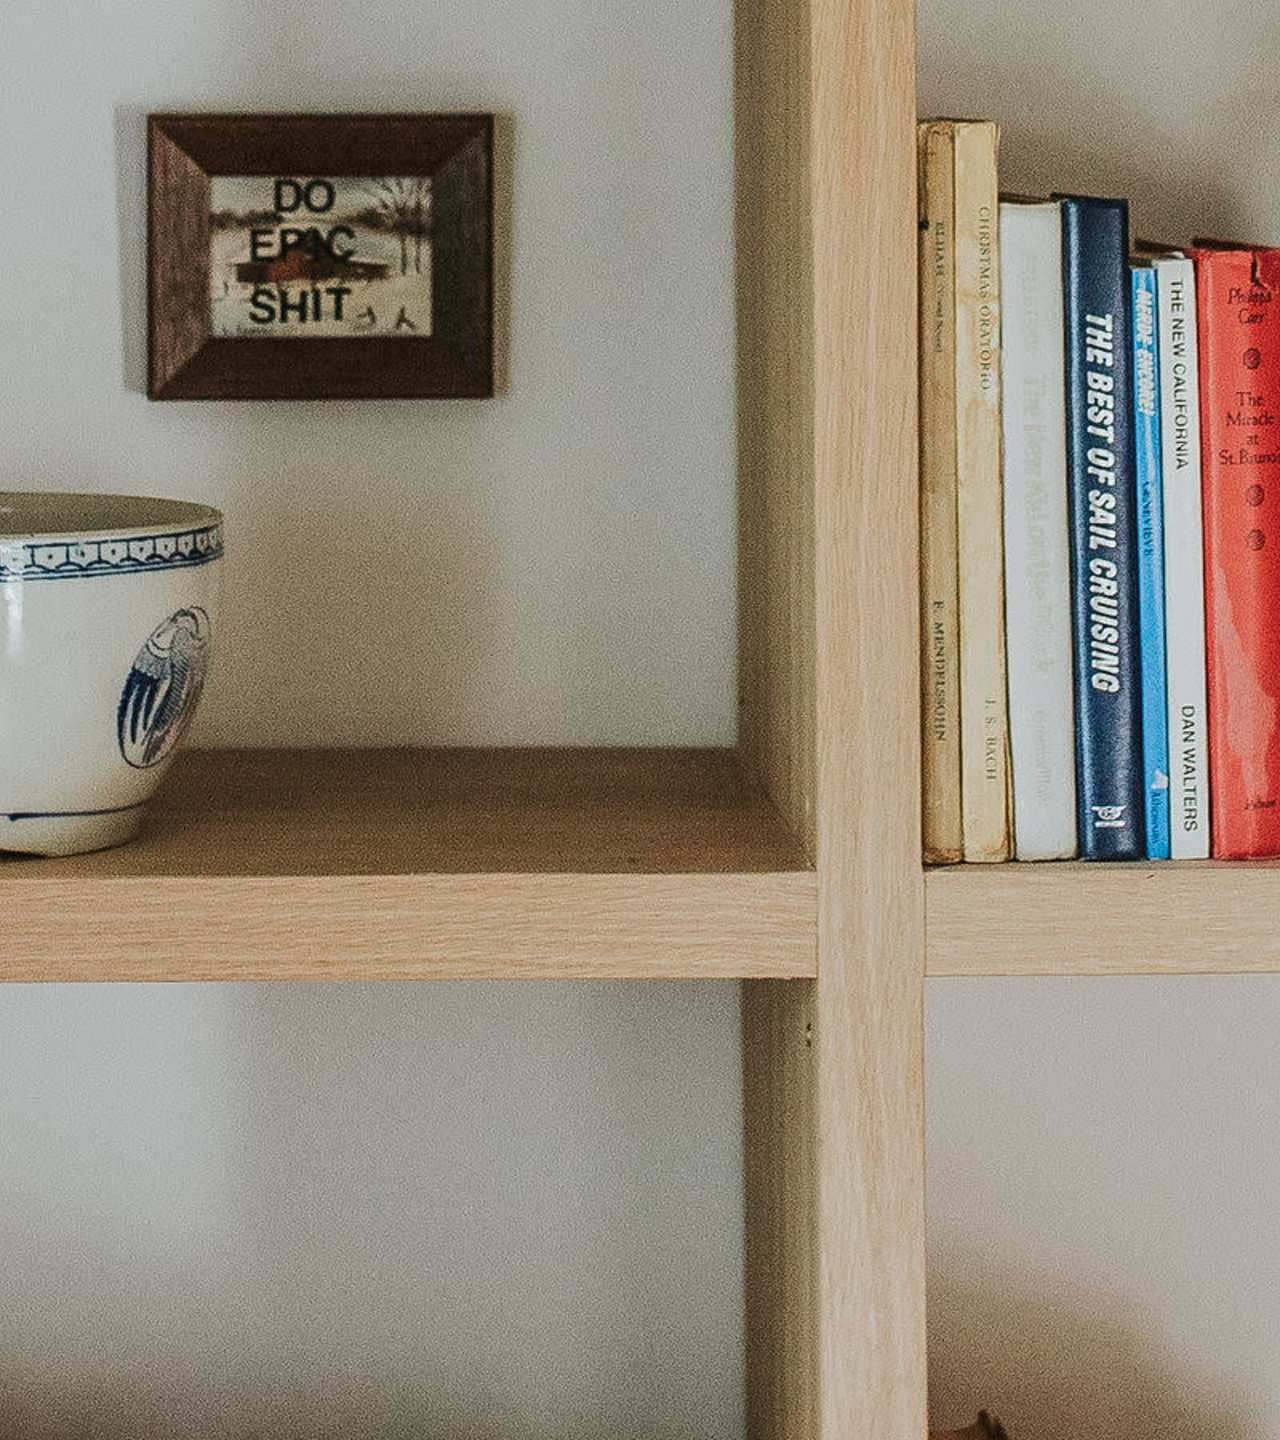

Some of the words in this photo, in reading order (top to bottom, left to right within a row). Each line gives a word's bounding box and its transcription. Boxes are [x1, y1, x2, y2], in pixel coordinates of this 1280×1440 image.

[275, 179, 335, 213] DO
[250, 225, 355, 263] EPIC
[249, 286, 352, 324] SHIT
[1169, 278, 1185, 313] THE
[1085, 313, 1114, 367] THE
[1171, 318, 1186, 357] NEW
[1086, 371, 1115, 444] BEST
[1173, 363, 1189, 471] CALIFORNIA
[1087, 447, 1116, 485] OF
[1088, 489, 1115, 550] SAIL
[1089, 558, 1119, 693] CRUISING
[1181, 705, 1196, 744] DAN
[1182, 748, 1197, 832] WALTERS
